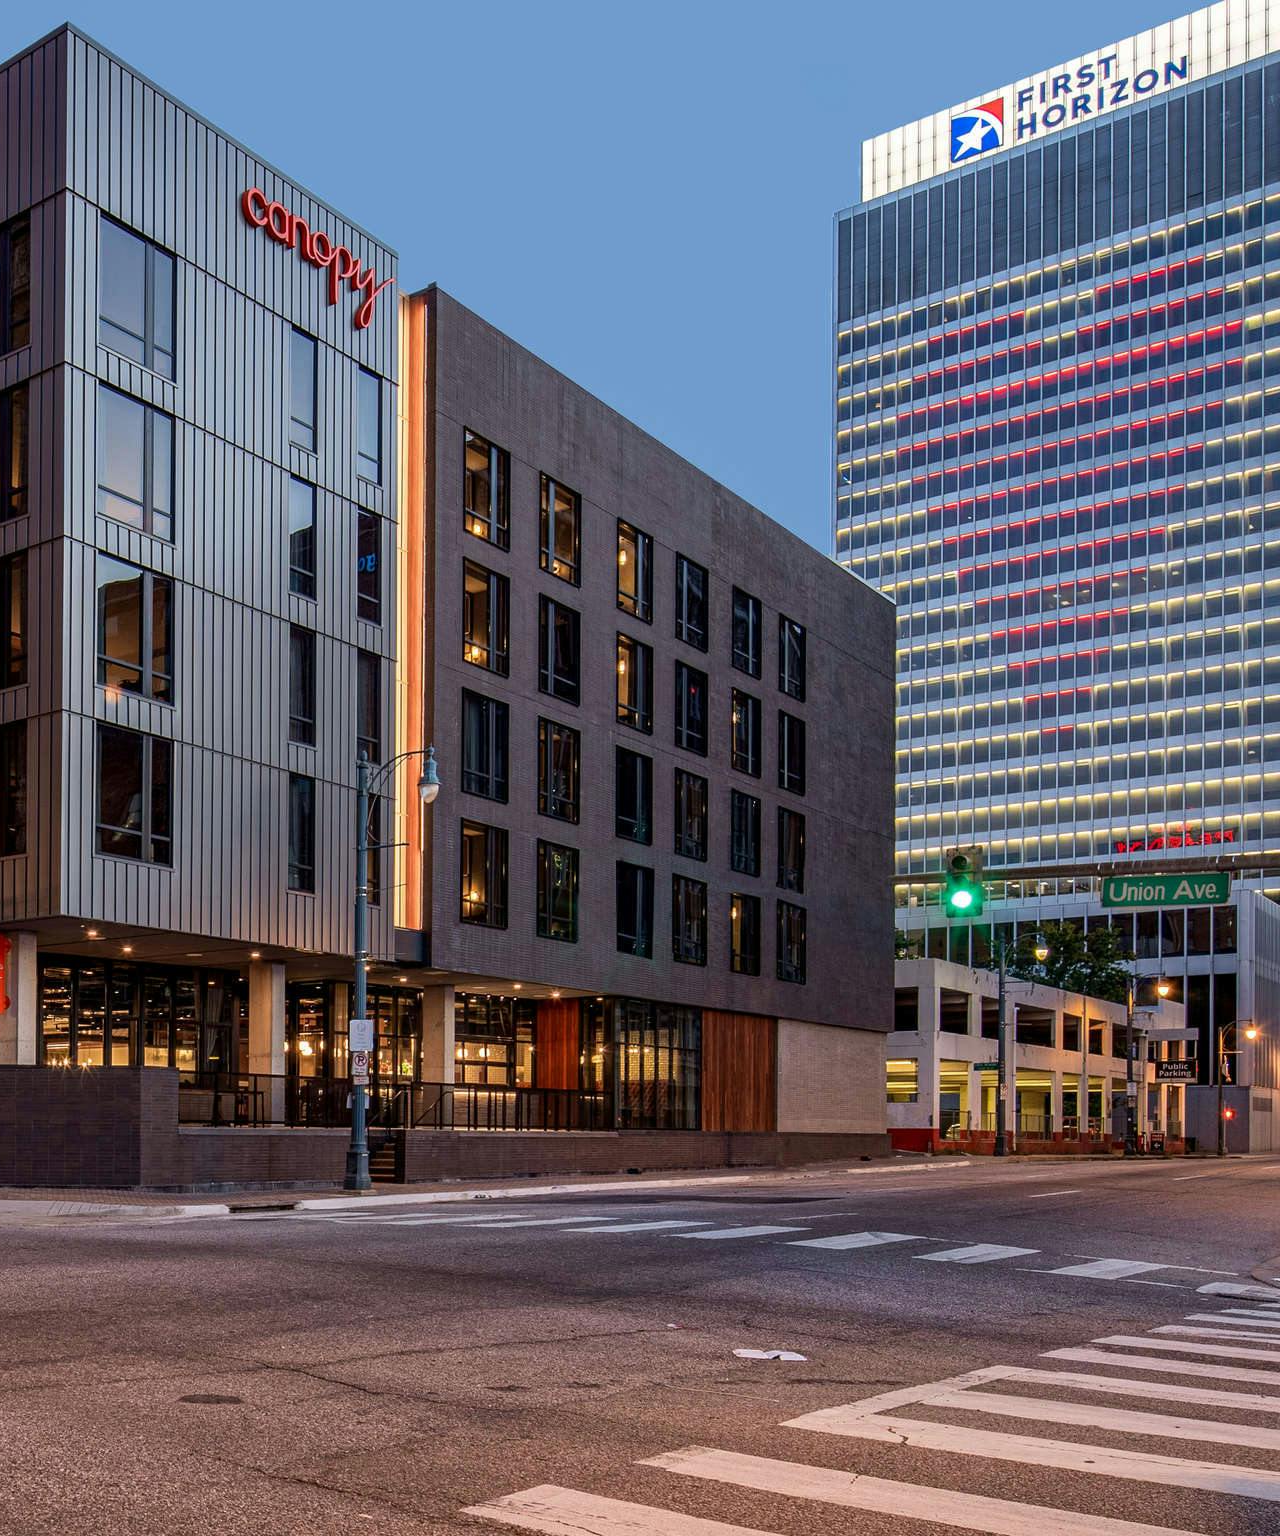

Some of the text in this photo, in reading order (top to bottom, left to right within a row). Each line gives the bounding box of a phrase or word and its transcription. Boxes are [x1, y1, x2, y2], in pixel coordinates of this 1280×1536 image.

[1017, 53, 1117, 112] FIRST
[1017, 55, 1188, 141] HORIZON
[241, 187, 395, 330] canopy
[1109, 879, 1220, 902] Union Ave.
[1160, 1070, 1191, 1078] Parking
